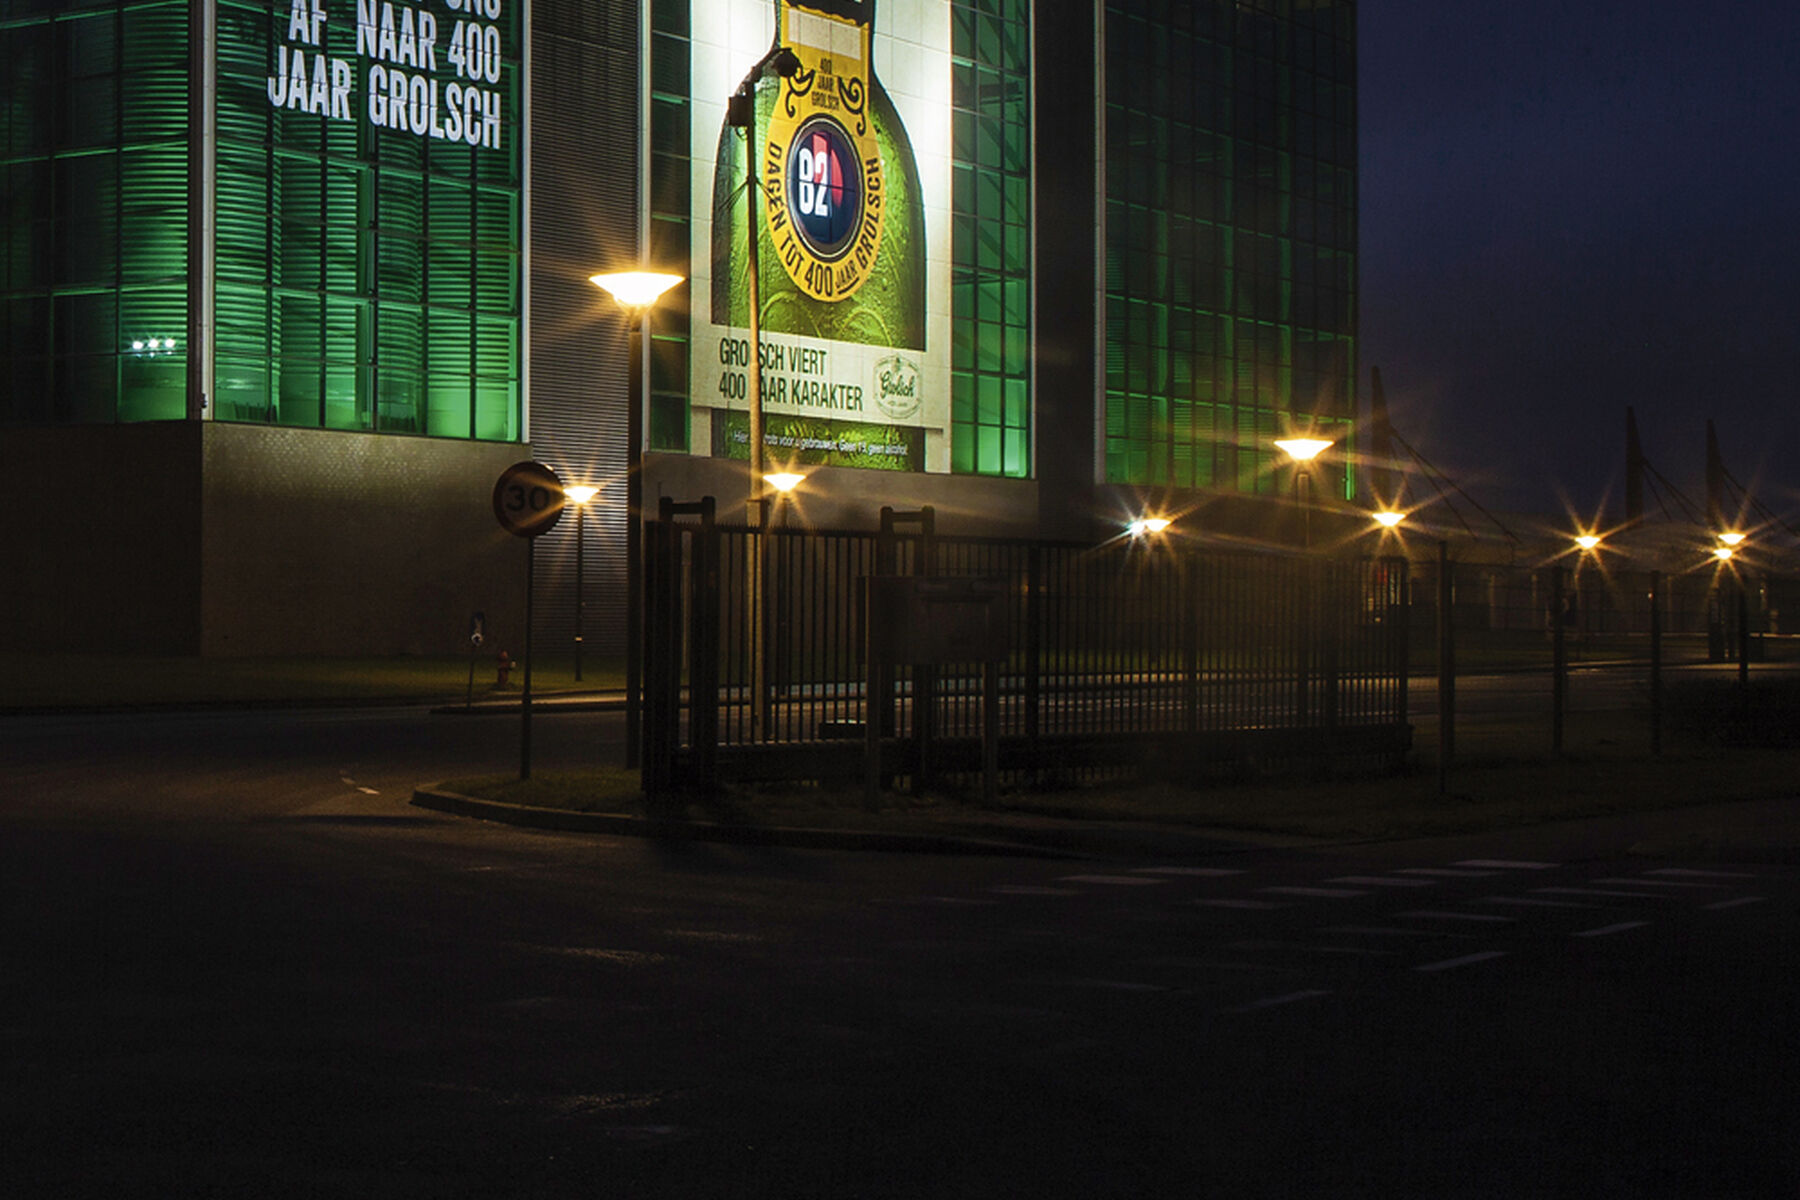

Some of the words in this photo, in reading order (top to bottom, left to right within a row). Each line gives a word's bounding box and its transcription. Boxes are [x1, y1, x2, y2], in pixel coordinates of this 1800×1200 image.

[448, 20, 501, 84] 400
[268, 45, 350, 121] JAAR
[368, 64, 501, 149] GROLSCH
[799, 148, 828, 216] 82
[768, 141, 787, 231] DAGEN
[780, 230, 804, 276] TOT
[805, 261, 832, 297] 400
[855, 158, 880, 269] GROLSCH
[719, 337, 784, 371] GROSCH
[788, 346, 826, 376] VIERT
[719, 372, 746, 400] 400
[760, 375, 787, 403] AAR
[791, 380, 863, 411] KARAKTER
[506, 485, 550, 511] 30
